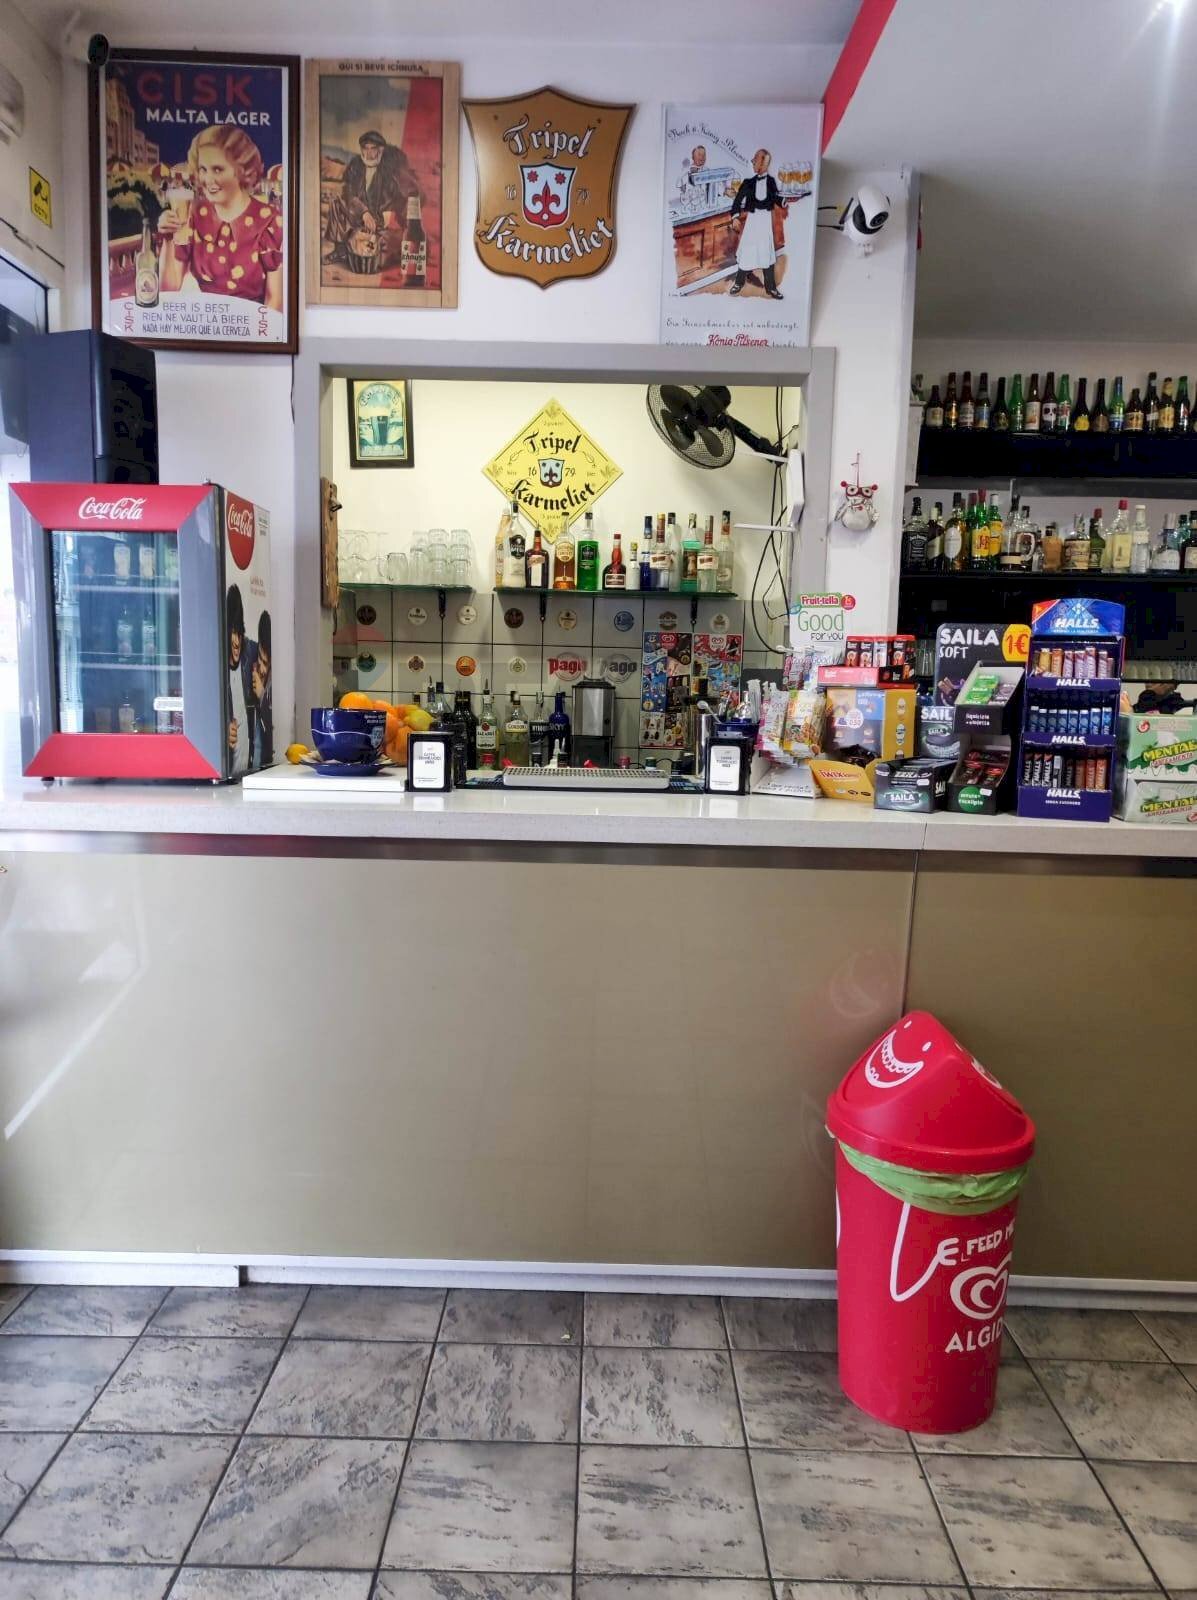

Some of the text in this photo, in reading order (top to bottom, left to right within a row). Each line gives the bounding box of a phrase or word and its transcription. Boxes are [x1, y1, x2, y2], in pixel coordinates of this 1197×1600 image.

[136, 69, 253, 105] CISK
[146, 107, 271, 126] MALTA LAGER
[503, 113, 597, 159] Tripel
[477, 213, 614, 264] Karmeliet
[123, 301, 134, 332] CISK
[163, 302, 231, 313] BEER IS BEST
[142, 312, 250, 325] RIEN NE VAUT LA BIERE
[257, 306, 269, 337] CISK
[142, 323, 251, 337] NADA HAY MEJOR QUE LA CERVEZA
[523, 430, 582, 456] Tripel
[528, 466, 537, 477] 16
[564, 467, 576, 478] 79
[506, 478, 595, 511] Karmeliet
[79, 496, 147, 520] Coca-Cola
[228, 503, 254, 538] Coca-Cola
[801, 595, 839, 606] Fruit-tella
[797, 610, 845, 632] Good
[1055, 618, 1100, 629] HALLS
[940, 628, 1000, 646] SAILA
[939, 646, 969, 659] SOFT
[1056, 678, 1091, 687] HALLS
[921, 707, 953, 720] SAIL
[1051, 735, 1086, 746] HALLS
[890, 793, 915, 802] SAILA
[1047, 789, 1080, 799] HALLS
[966, 1218, 1015, 1256] FEED M
[944, 1317, 1004, 1353] ALGID
